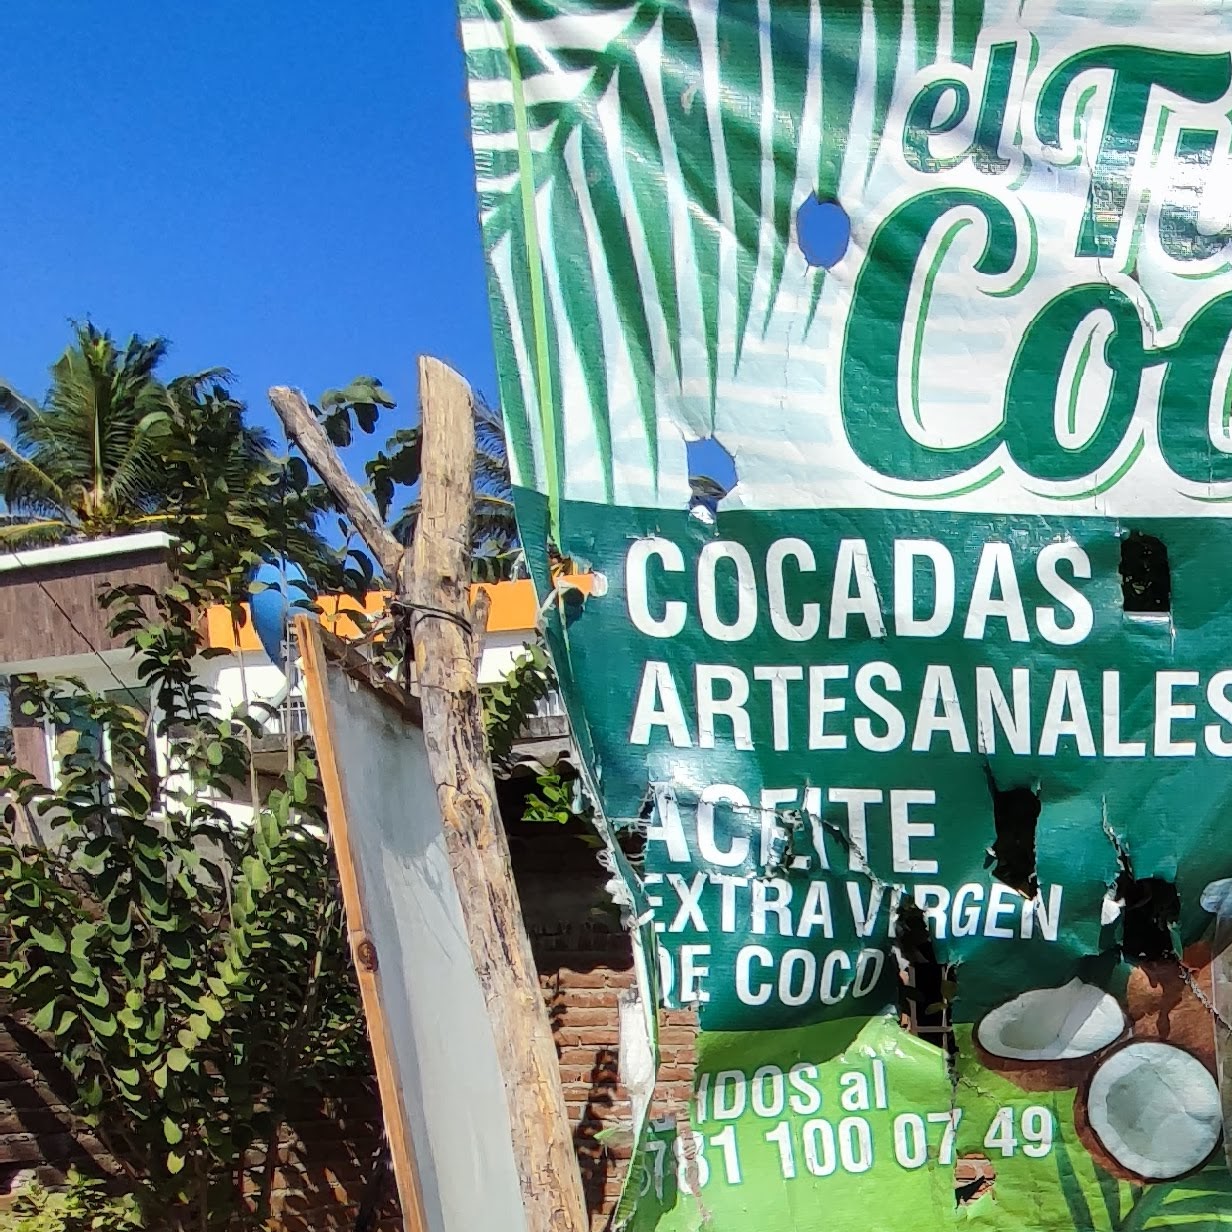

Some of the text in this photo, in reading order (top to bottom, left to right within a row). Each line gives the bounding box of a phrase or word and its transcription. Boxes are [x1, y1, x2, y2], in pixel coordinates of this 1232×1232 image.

[902, 40, 1018, 176] el
[624, 535, 1095, 645] COCADAS
[646, 782, 939, 874] ACEITE
[644, 872, 1064, 942] EXTRA VIRGEN
[735, 944, 886, 1007] COCO
[652, 1058, 888, 1131] IDOS al
[765, 1116, 873, 1179] 100
[893, 1108, 963, 1169] 07
[983, 1105, 1053, 1158] 49
